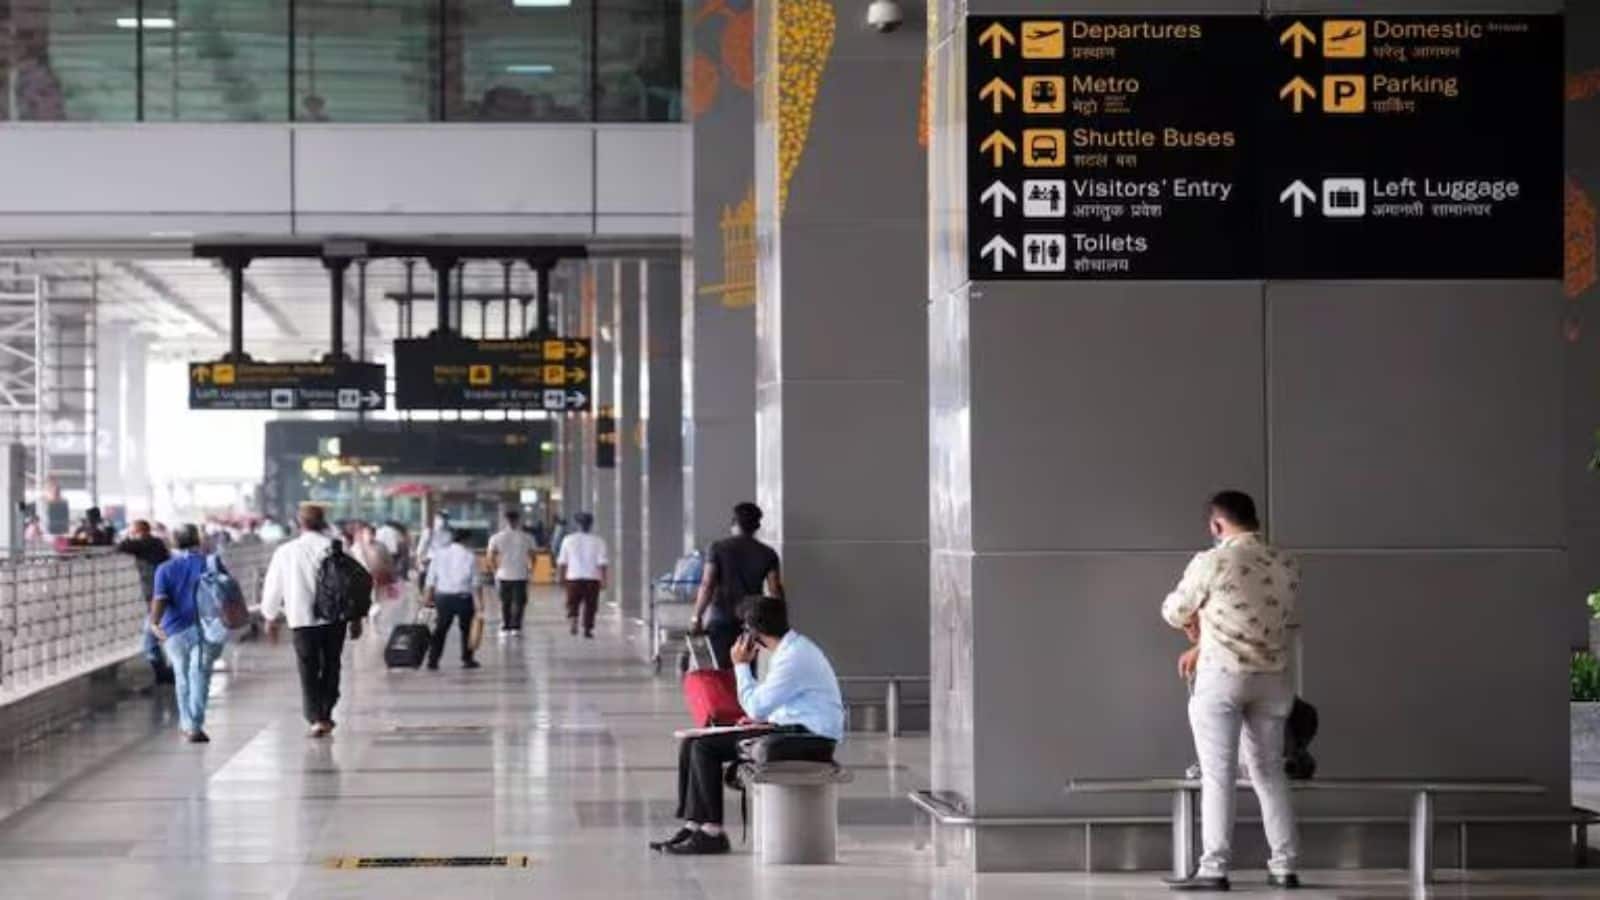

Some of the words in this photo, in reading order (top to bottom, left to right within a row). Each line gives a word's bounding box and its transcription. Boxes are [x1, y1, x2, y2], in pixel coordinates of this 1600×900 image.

[1072, 20, 1202, 42] Departures
[1373, 19, 1482, 39] Domestic
[1072, 74, 1140, 93] Metro
[1373, 74, 1459, 97] Parking
[1073, 127, 1156, 147] Shuttle
[1163, 127, 1236, 147] Buses
[1072, 178, 1168, 198] Visitors'
[1173, 178, 1233, 203] Entry
[1373, 177, 1417, 197] Left
[1425, 177, 1520, 202] Luggage
[1072, 232, 1149, 252] Toilets
